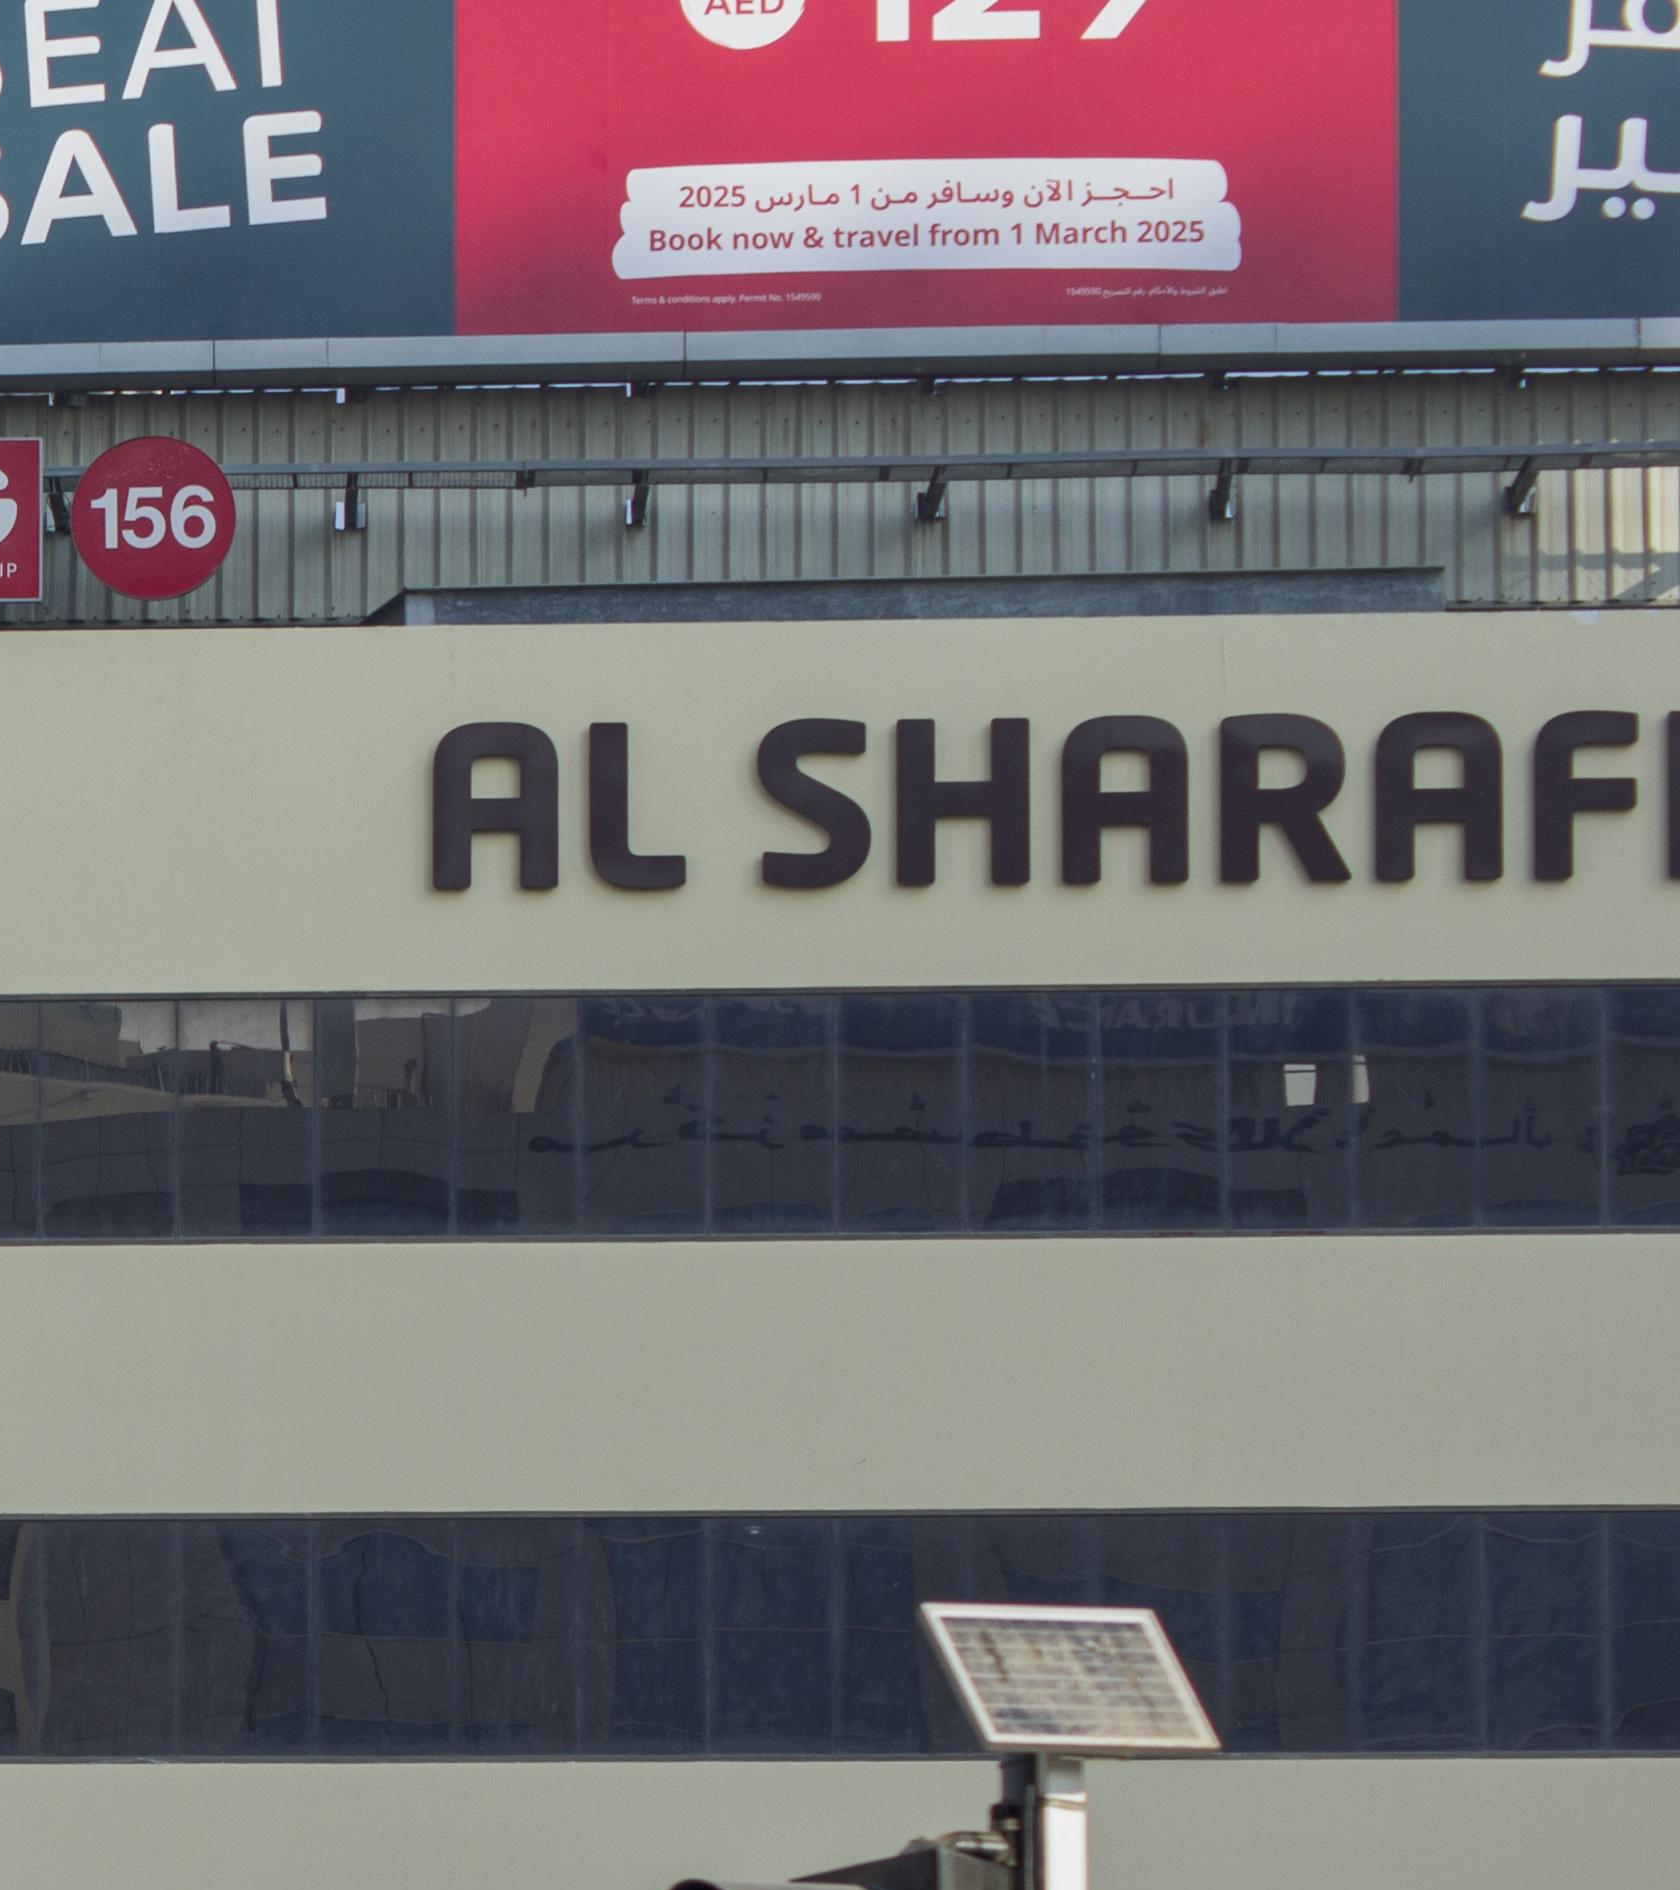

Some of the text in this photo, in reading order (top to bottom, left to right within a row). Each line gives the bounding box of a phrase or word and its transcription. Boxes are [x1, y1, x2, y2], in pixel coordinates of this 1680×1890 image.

[678, 186, 746, 209] 2025
[755, 184, 840, 213] مارس
[849, 186, 860, 206] 1
[649, 219, 1205, 253] Book now & travel from 1 March 2025
[91, 486, 217, 550] 156
[436, 720, 687, 893] AL
